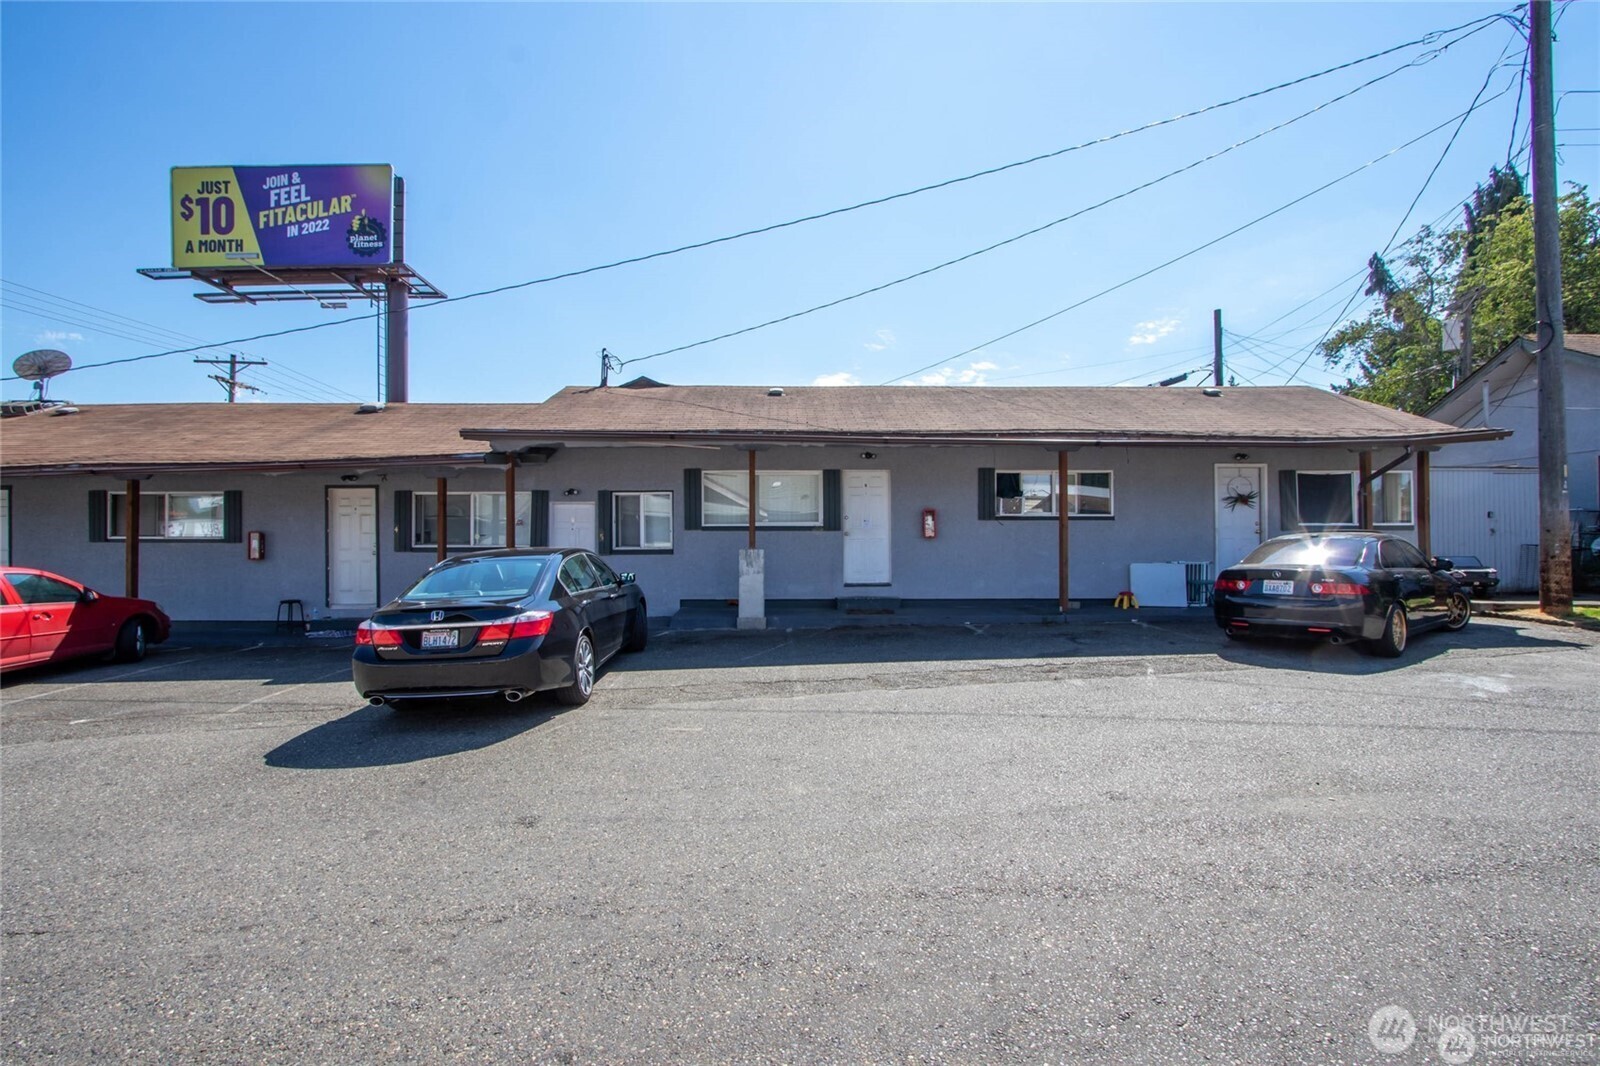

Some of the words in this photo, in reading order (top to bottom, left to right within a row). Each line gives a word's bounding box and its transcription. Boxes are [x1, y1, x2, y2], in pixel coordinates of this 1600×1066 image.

[197, 181, 230, 194] JUST
[262, 174, 288, 190] JOIN
[292, 172, 300, 182] &
[270, 184, 310, 208] FEEL
[180, 194, 235, 235] $10
[287, 225, 298, 238] IN
[302, 220, 330, 234] 2022
[185, 241, 194, 253] A
[198, 239, 244, 252] MONTH
[350, 234, 377, 243] planet
